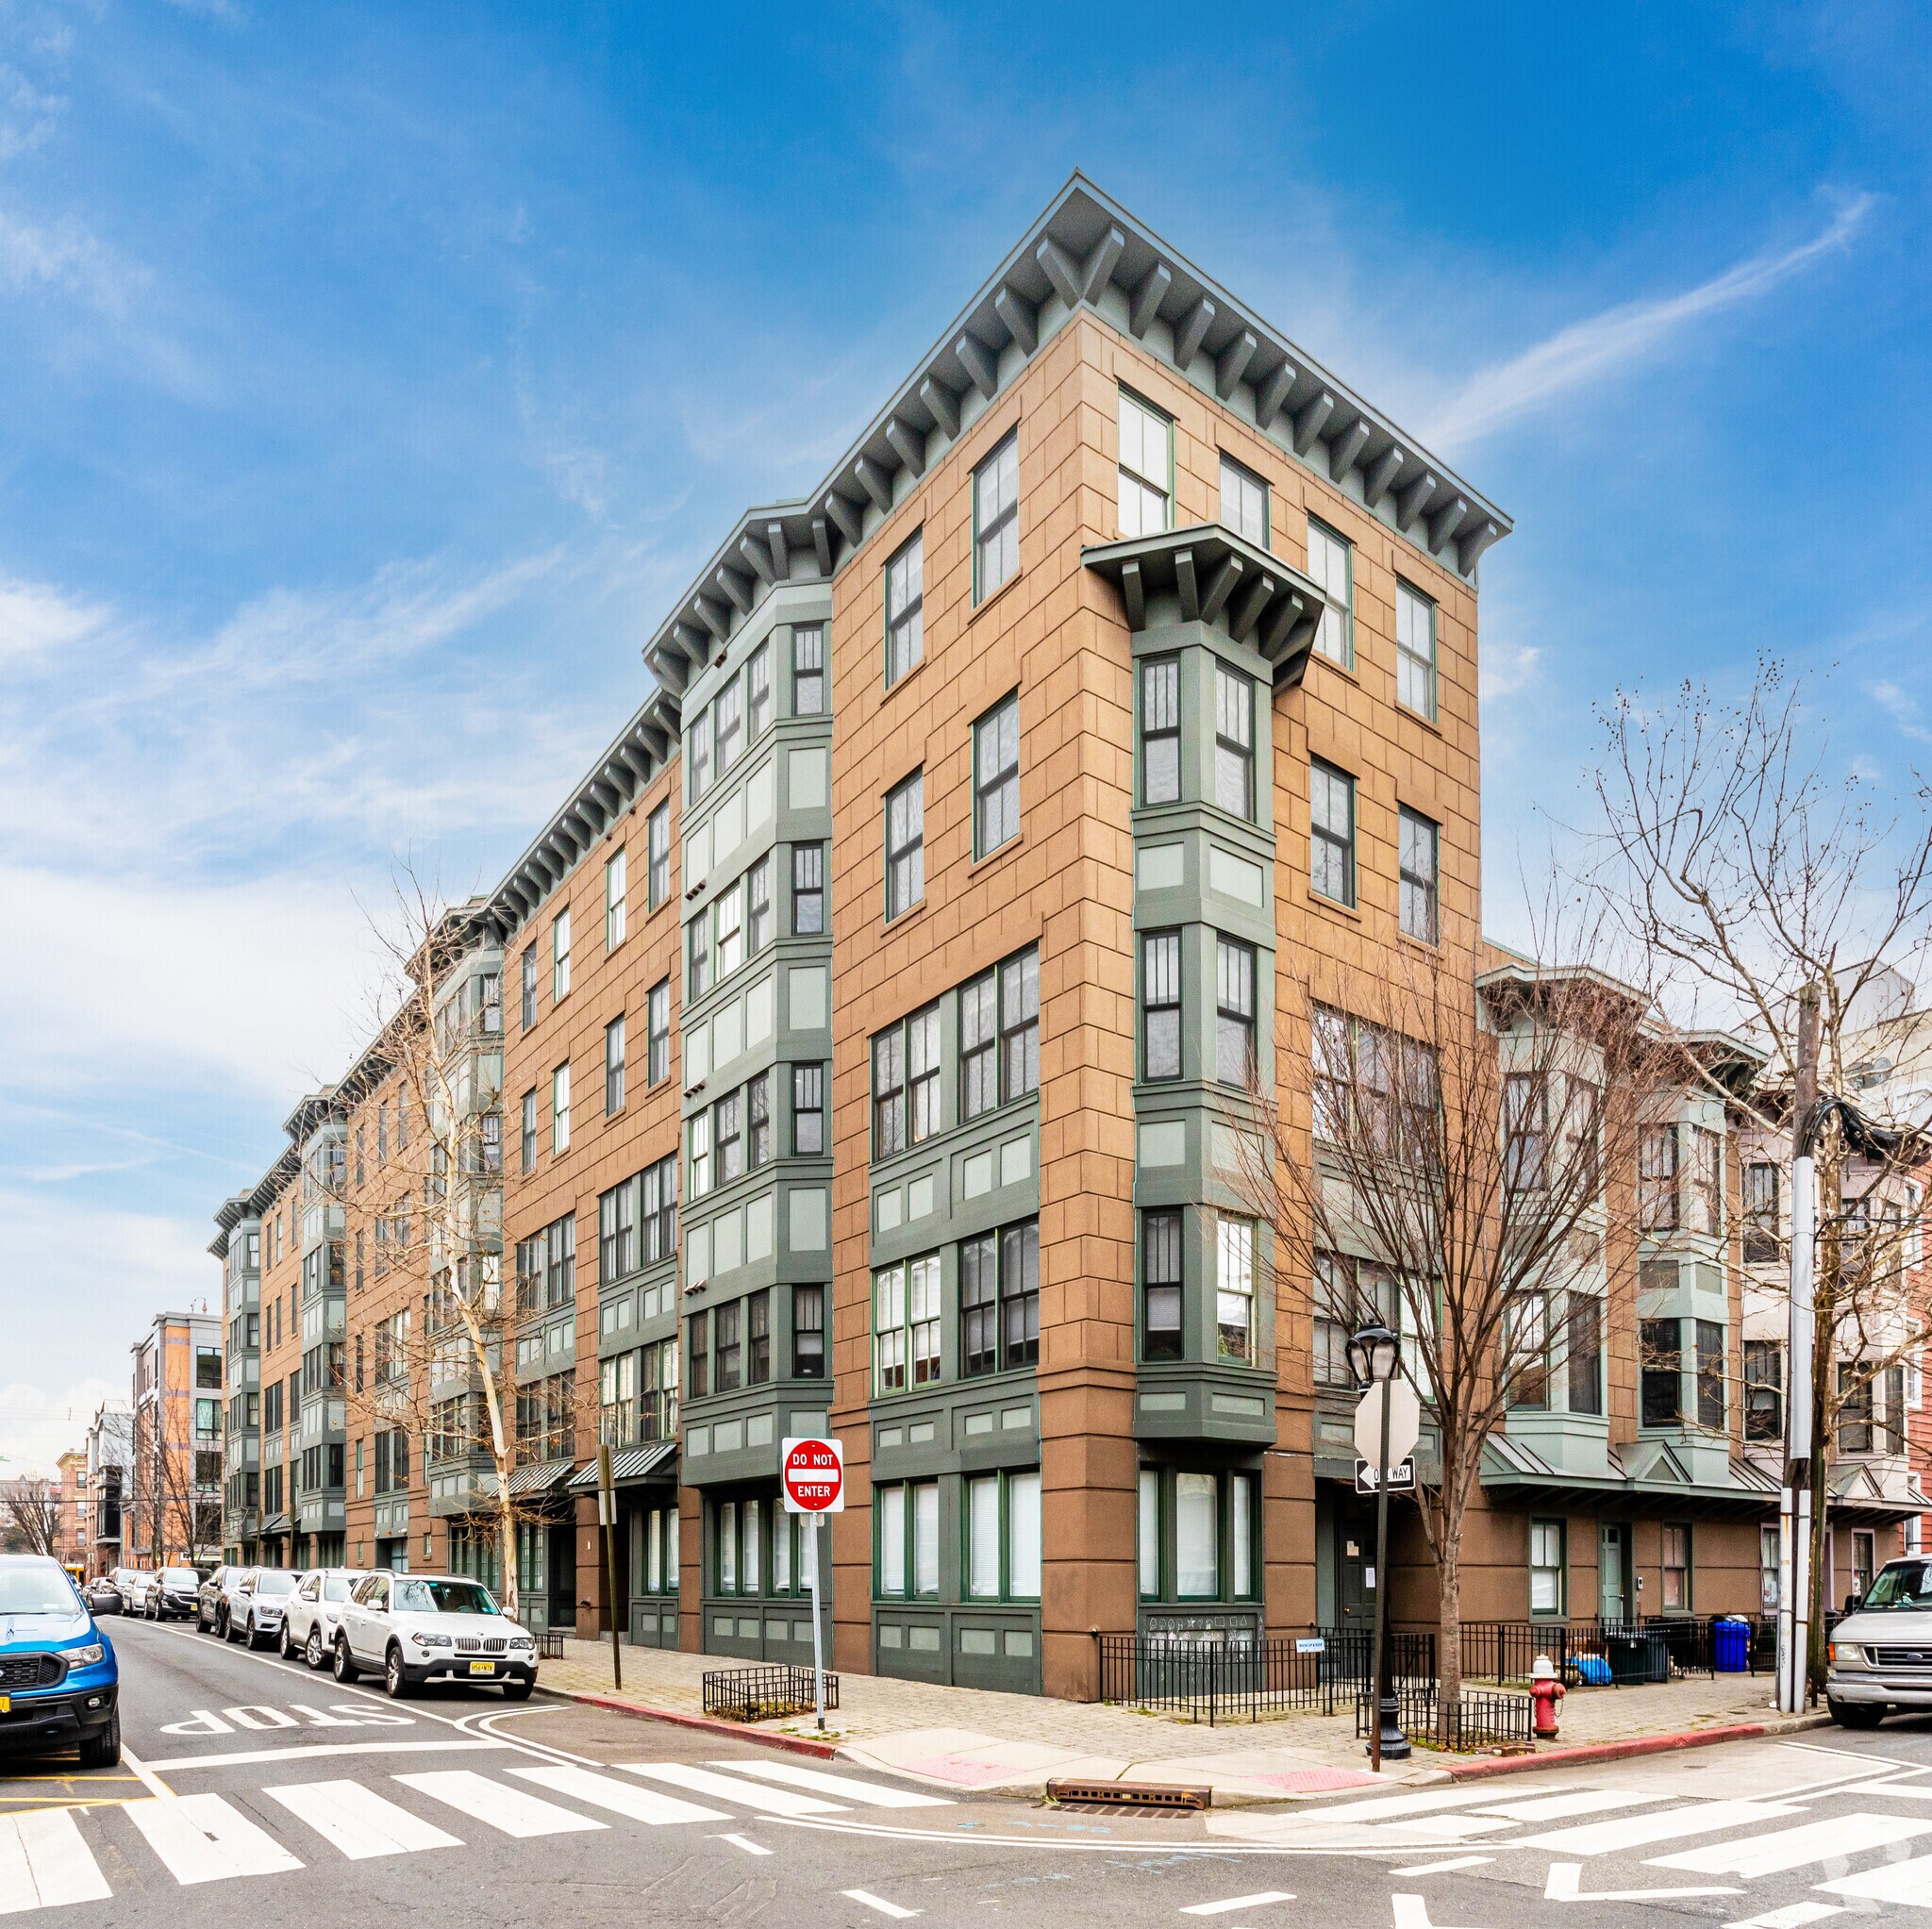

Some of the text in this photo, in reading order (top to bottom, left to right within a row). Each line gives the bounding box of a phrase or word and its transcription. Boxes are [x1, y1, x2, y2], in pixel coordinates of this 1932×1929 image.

[792, 1454, 833, 1466] DO NOT
[1391, 1467, 1407, 1479] WAY
[797, 1486, 830, 1497] ENTER
[159, 1705, 417, 1735] STOP
